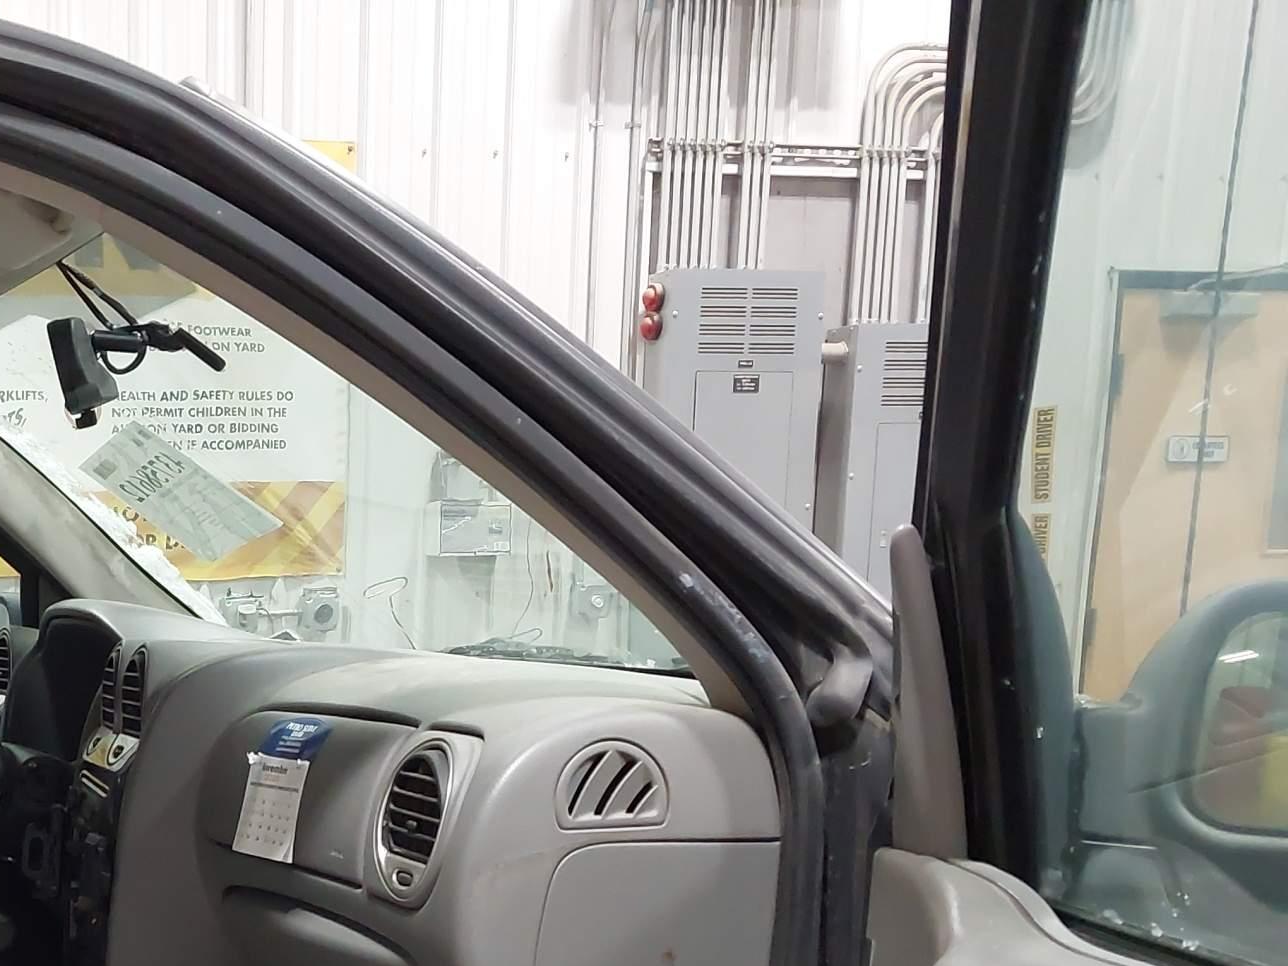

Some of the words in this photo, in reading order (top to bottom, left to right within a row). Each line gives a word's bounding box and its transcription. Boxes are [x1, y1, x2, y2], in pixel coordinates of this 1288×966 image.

[187, 324, 253, 337] FOOTWEAR
[234, 342, 266, 353] YARD
[117, 390, 156, 402] EALTH
[160, 391, 188, 402] AND
[193, 390, 234, 401] SAFETY
[239, 391, 273, 401] RULES
[277, 391, 294, 401] DO
[112, 407, 137, 418] NOT
[142, 406, 184, 418] PERMIT
[189, 406, 247, 418] CHILDREN
[251, 408, 263, 417] IN
[267, 408, 287, 418] THE
[172, 423, 203, 434] YARD
[207, 423, 225, 434] OR
[229, 422, 279, 433] BIDDING
[1035, 408, 1055, 449] DRIVER
[201, 439, 287, 450] ACCOMPANIED
[1034, 452, 1051, 500] STUDENT
